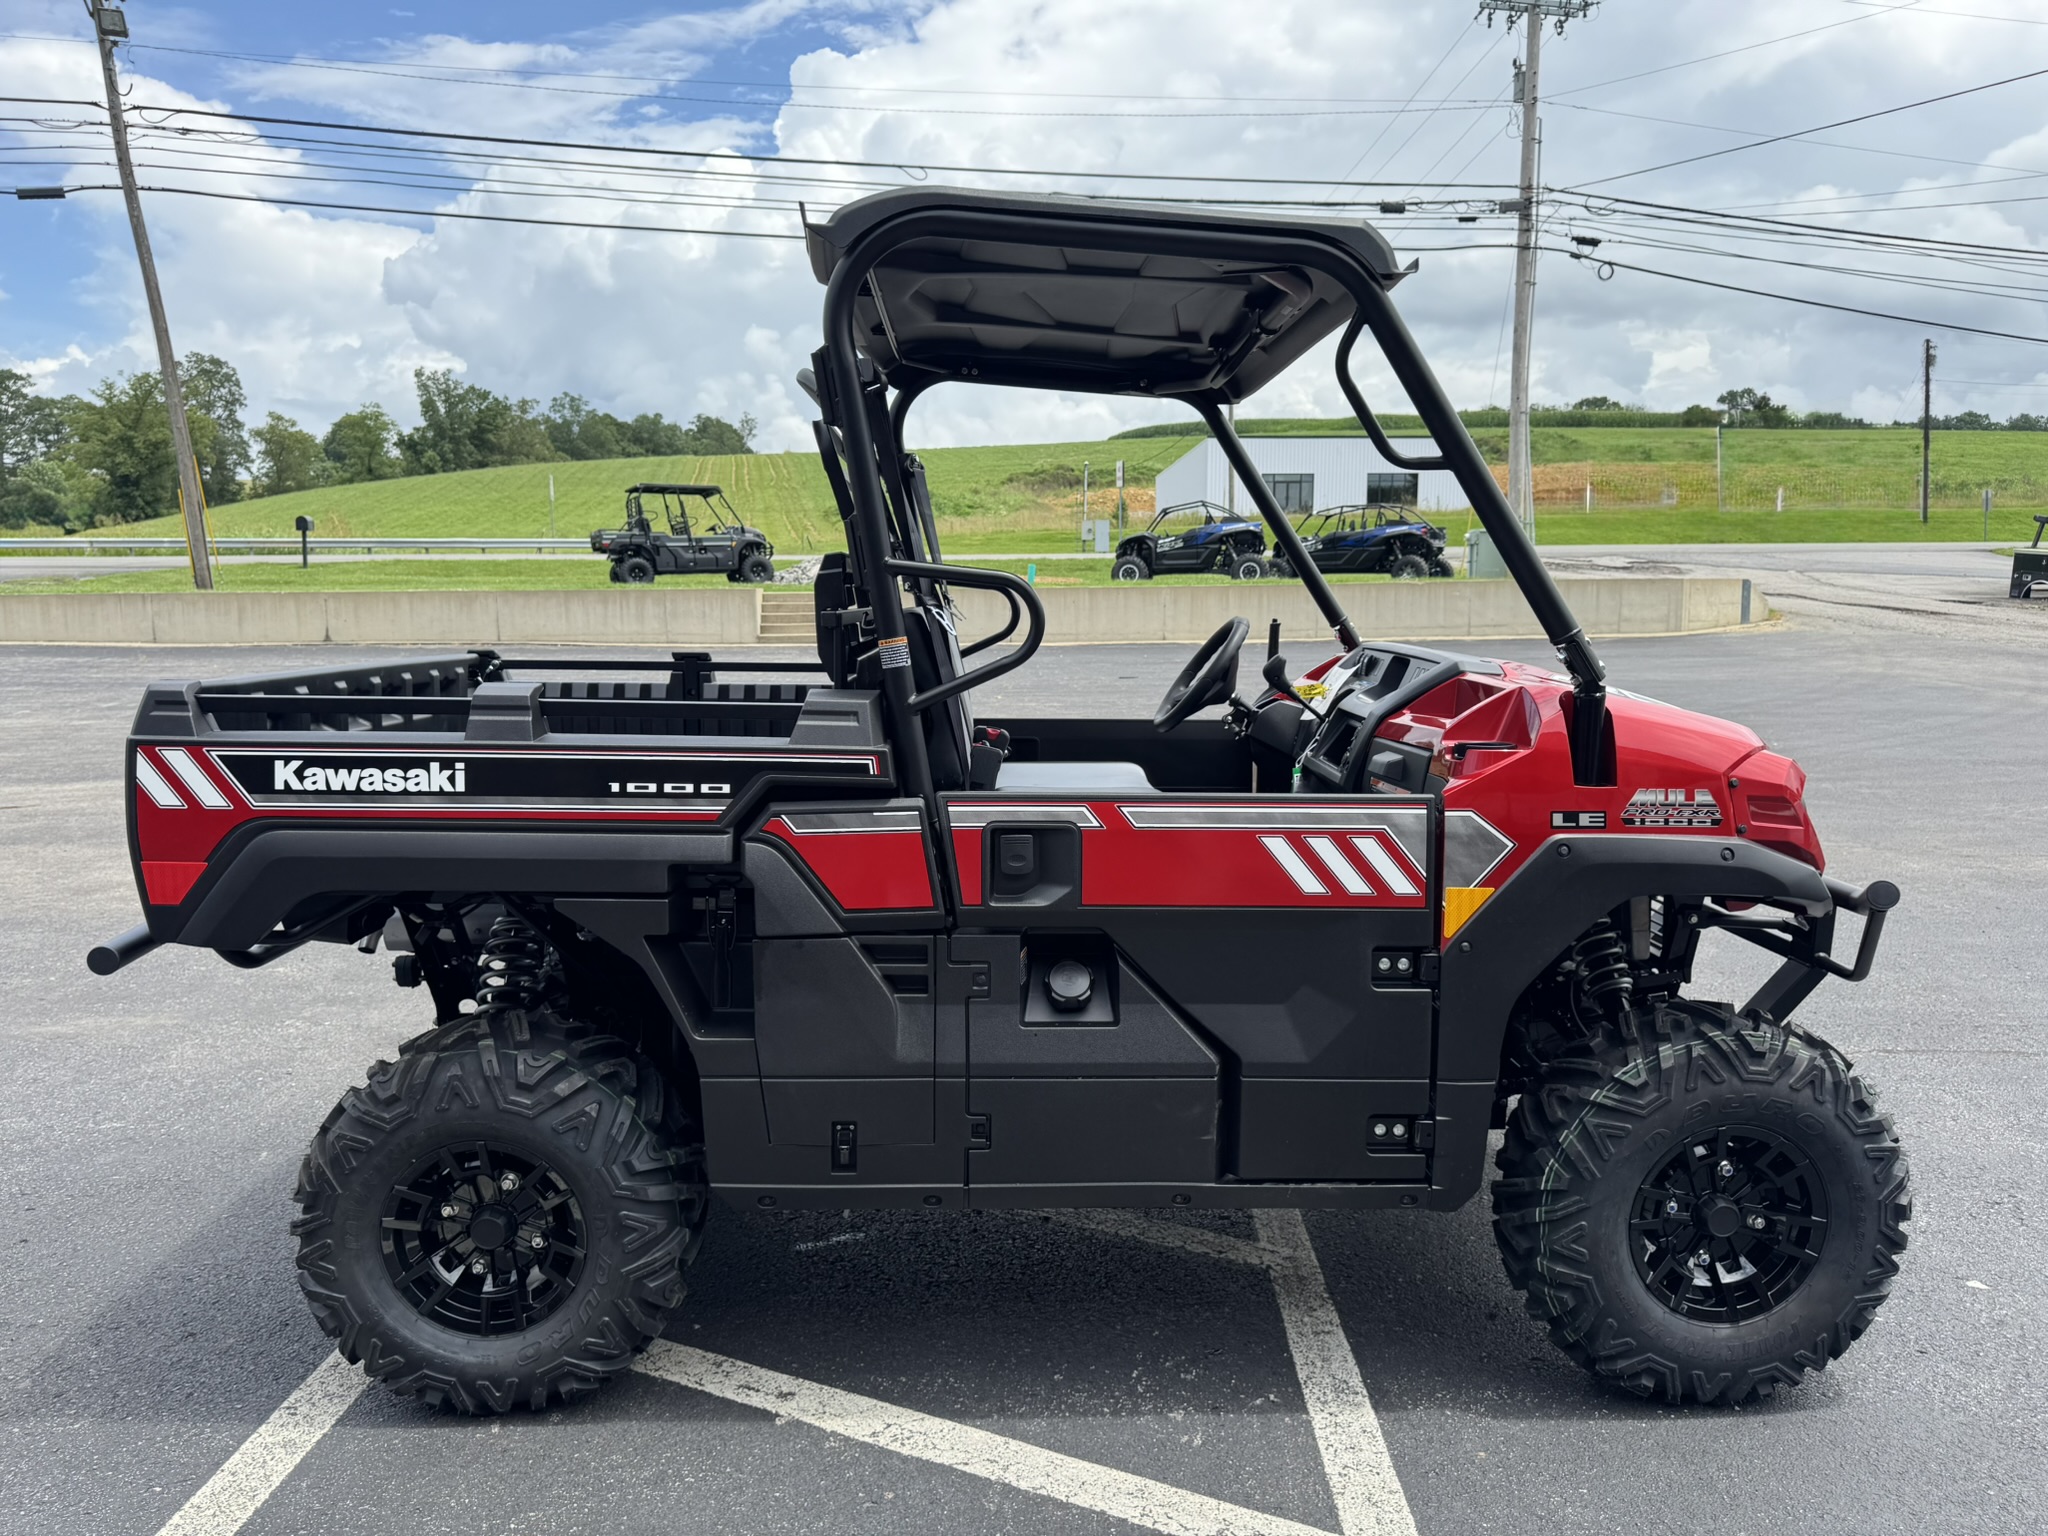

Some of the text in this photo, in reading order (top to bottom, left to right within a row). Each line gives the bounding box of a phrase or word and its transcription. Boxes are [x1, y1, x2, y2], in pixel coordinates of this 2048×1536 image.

[274, 760, 465, 792] Kawasaki
[608, 782, 731, 793] 1000
[1626, 788, 1720, 808] MULE
[1552, 813, 1605, 827] LE
[1621, 808, 1722, 818] PRO-FXR
[1632, 818, 1712, 826] 1000
[1684, 1093, 1826, 1135] DURO
[516, 1252, 612, 1366] DURO
